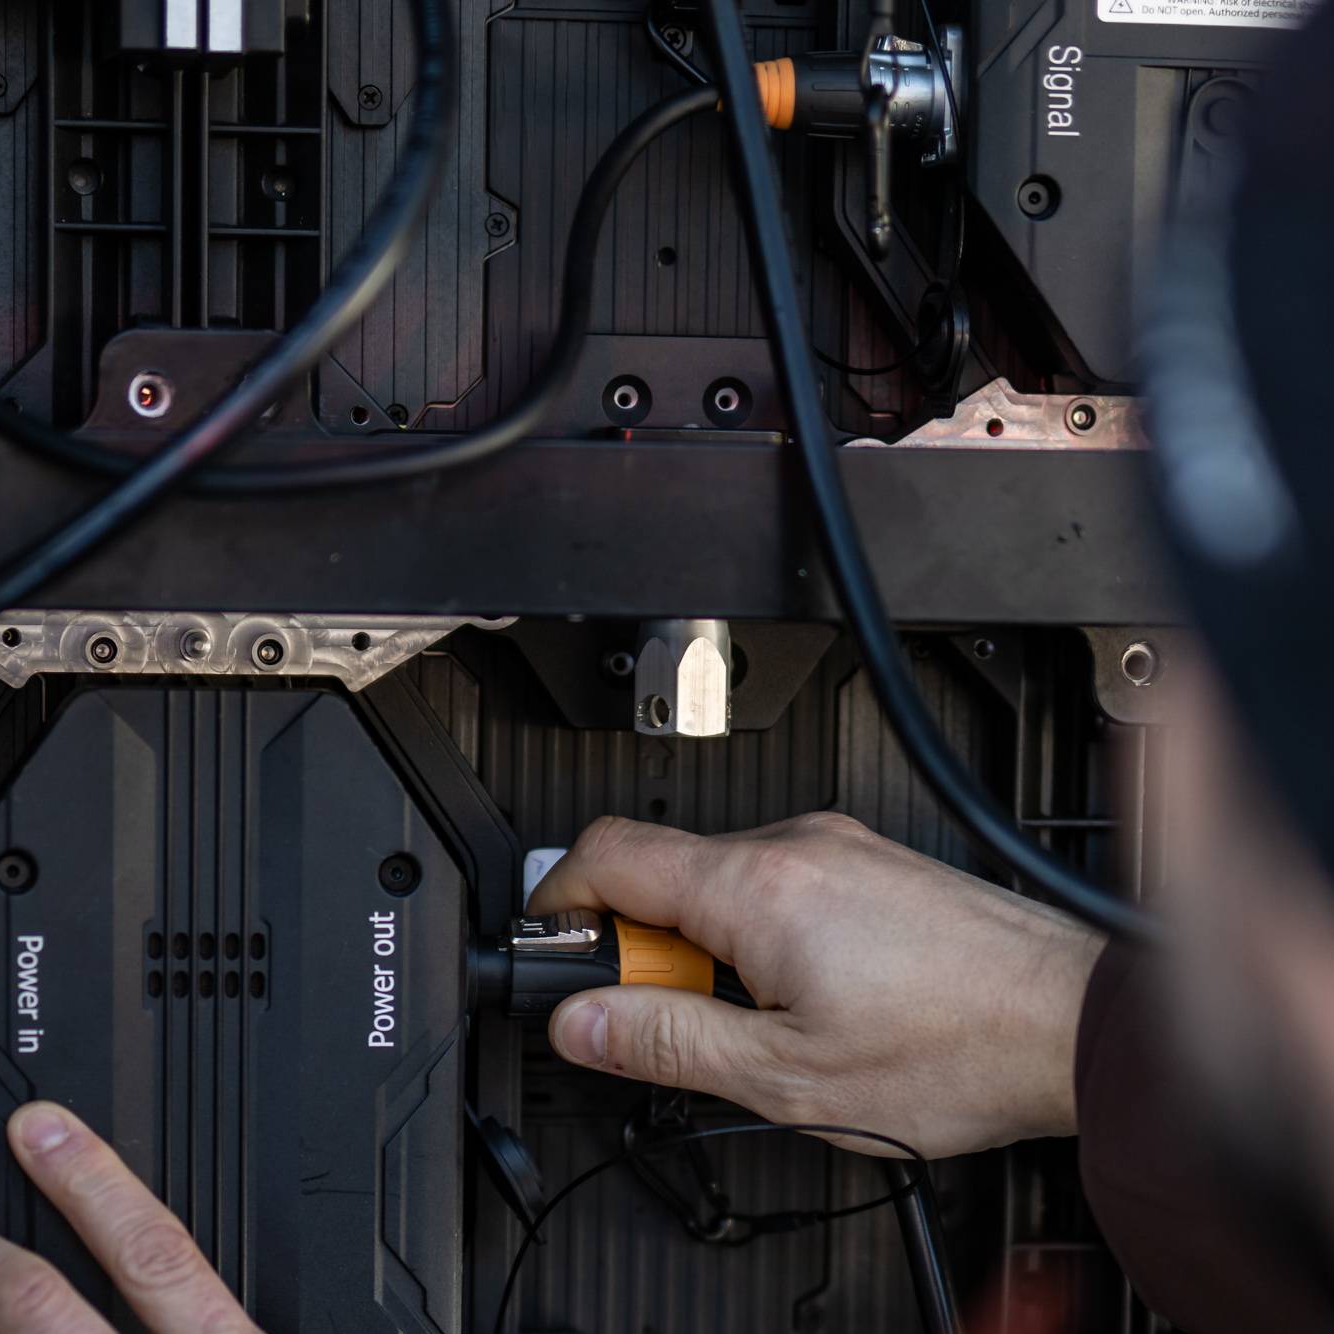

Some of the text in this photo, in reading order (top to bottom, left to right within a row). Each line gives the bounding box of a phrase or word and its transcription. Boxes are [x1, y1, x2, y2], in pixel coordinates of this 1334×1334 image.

[1209, 7, 1260, 18] Authorized
[1043, 45, 1082, 136] Signal
[17, 936, 45, 1054] Power in
[368, 911, 395, 1047] Power out
